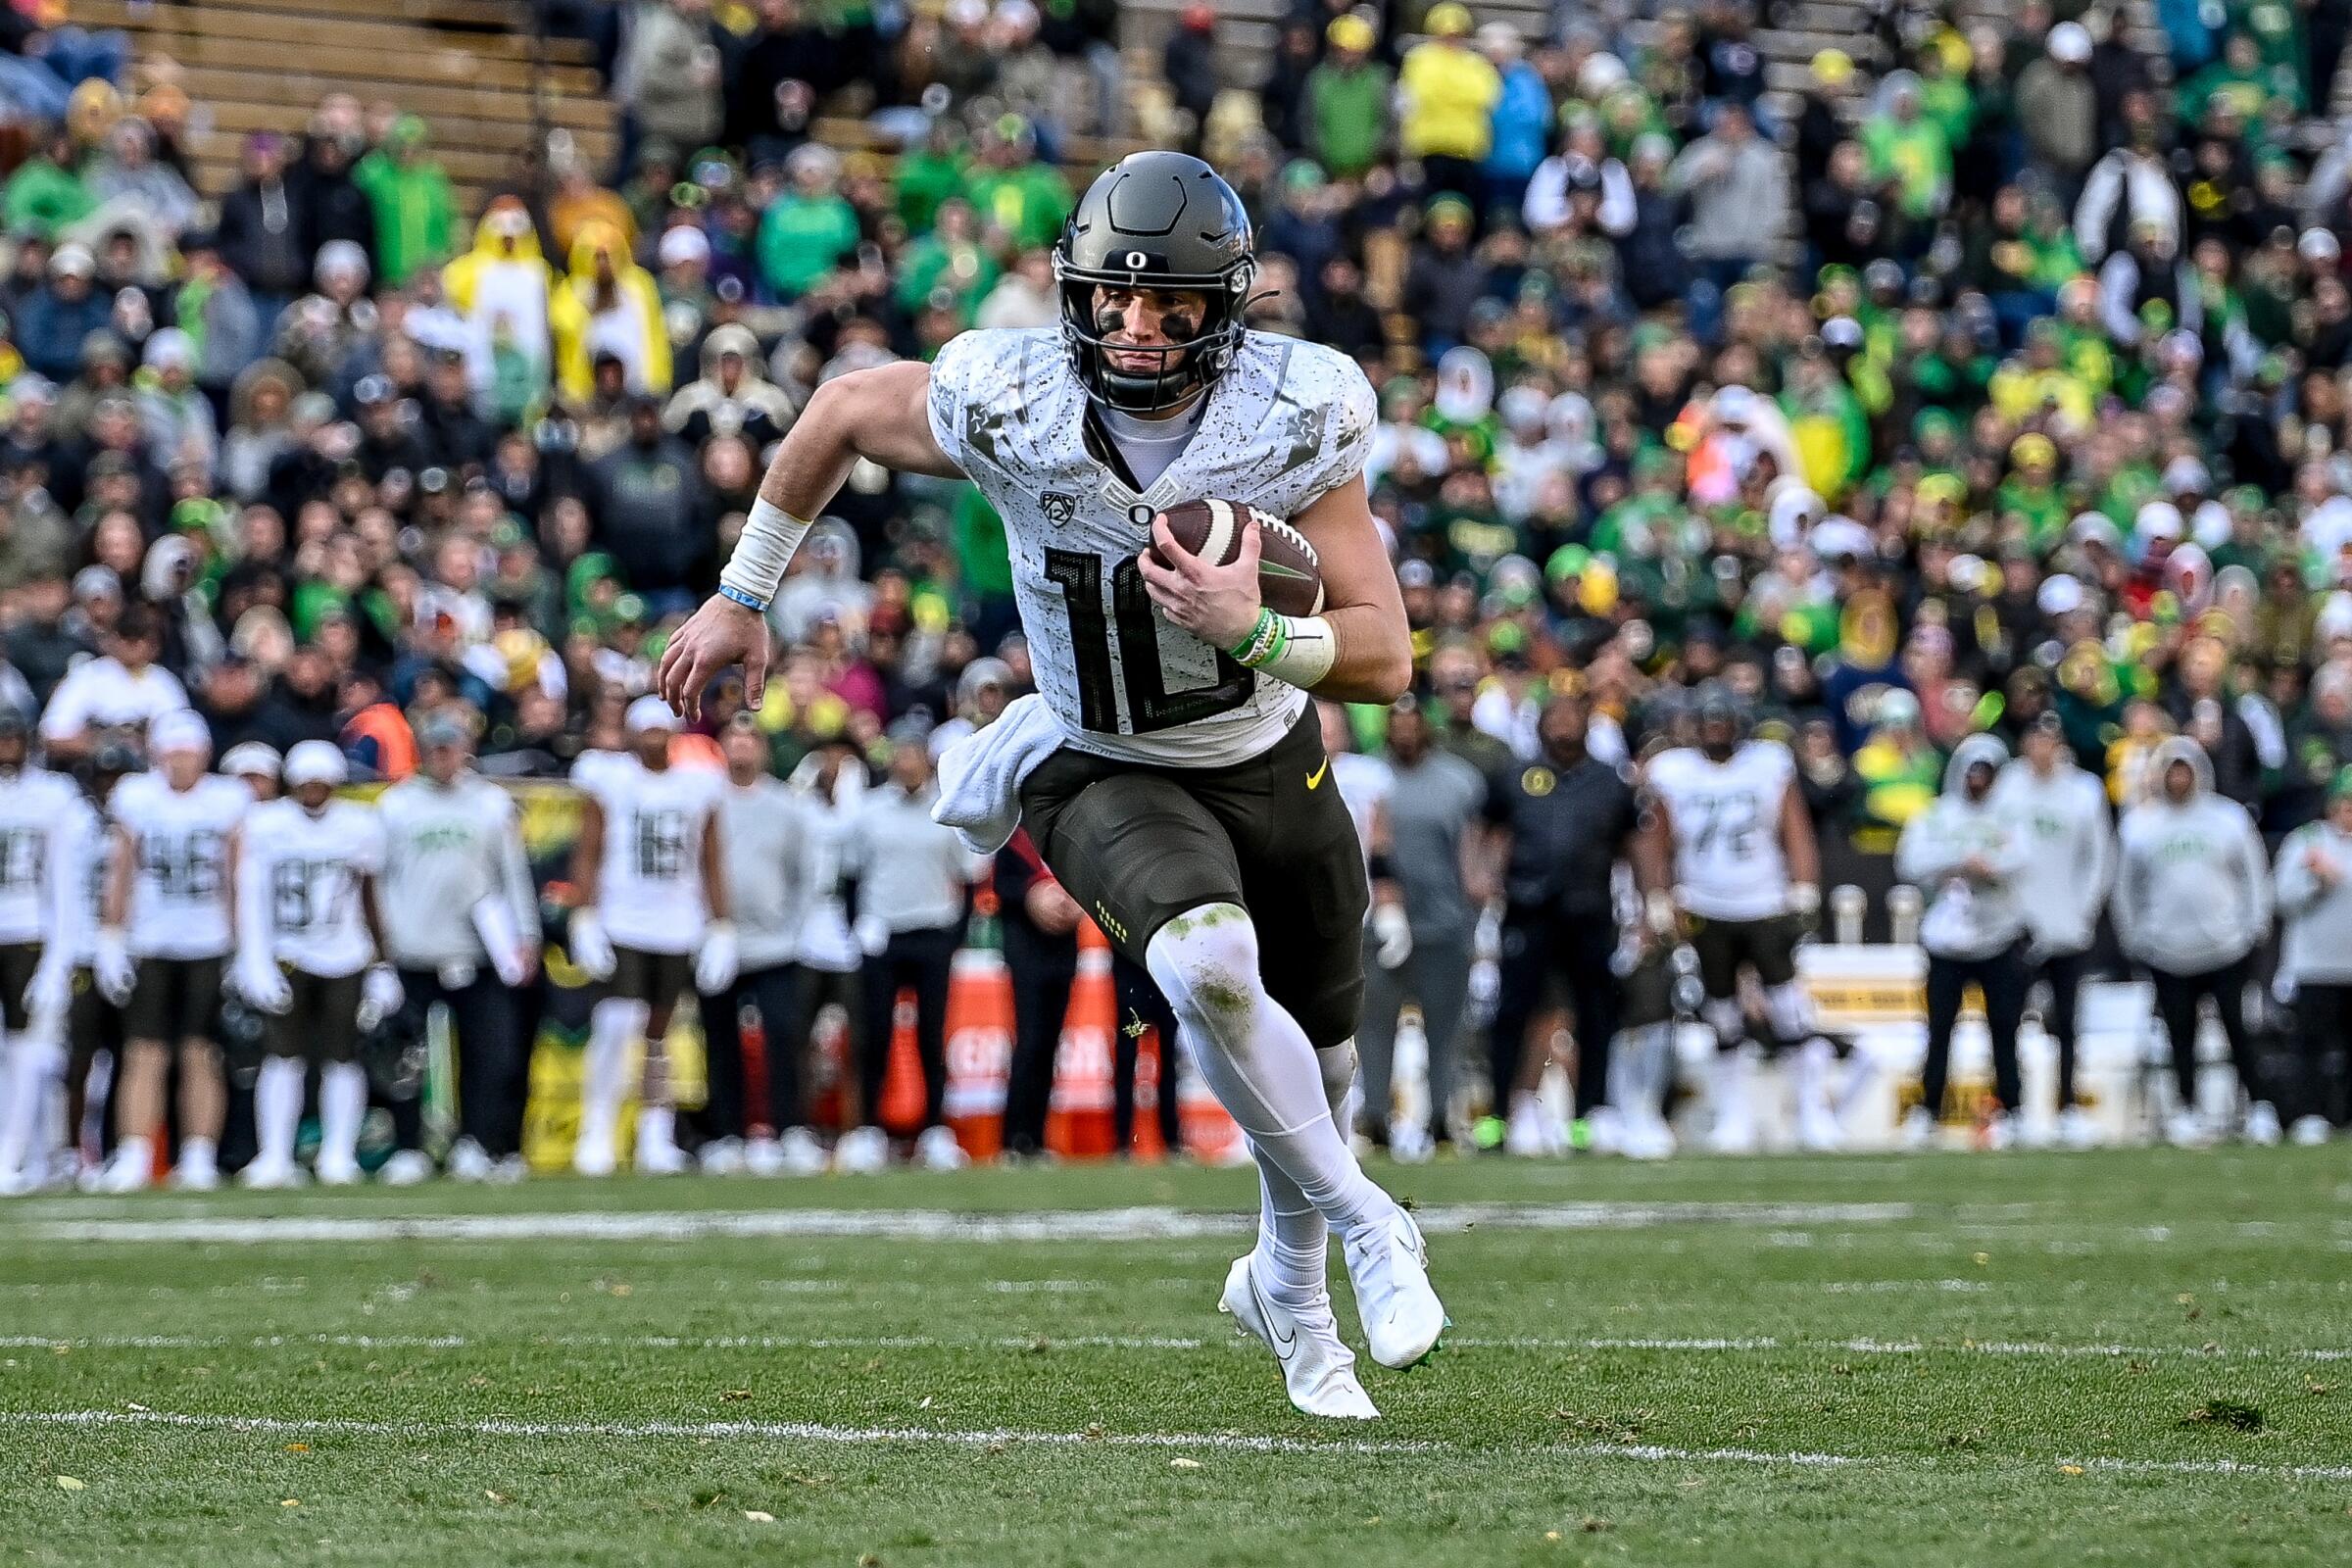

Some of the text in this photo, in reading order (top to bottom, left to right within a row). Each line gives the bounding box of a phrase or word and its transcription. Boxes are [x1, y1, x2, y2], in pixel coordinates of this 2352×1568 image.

[1126, 252, 1147, 269] O
[1042, 493, 1074, 516] PAC
[1049, 508, 1065, 522] 12
[1127, 503, 1155, 525] O
[1043, 546, 1255, 734] 10
[1689, 790, 1759, 861] 72
